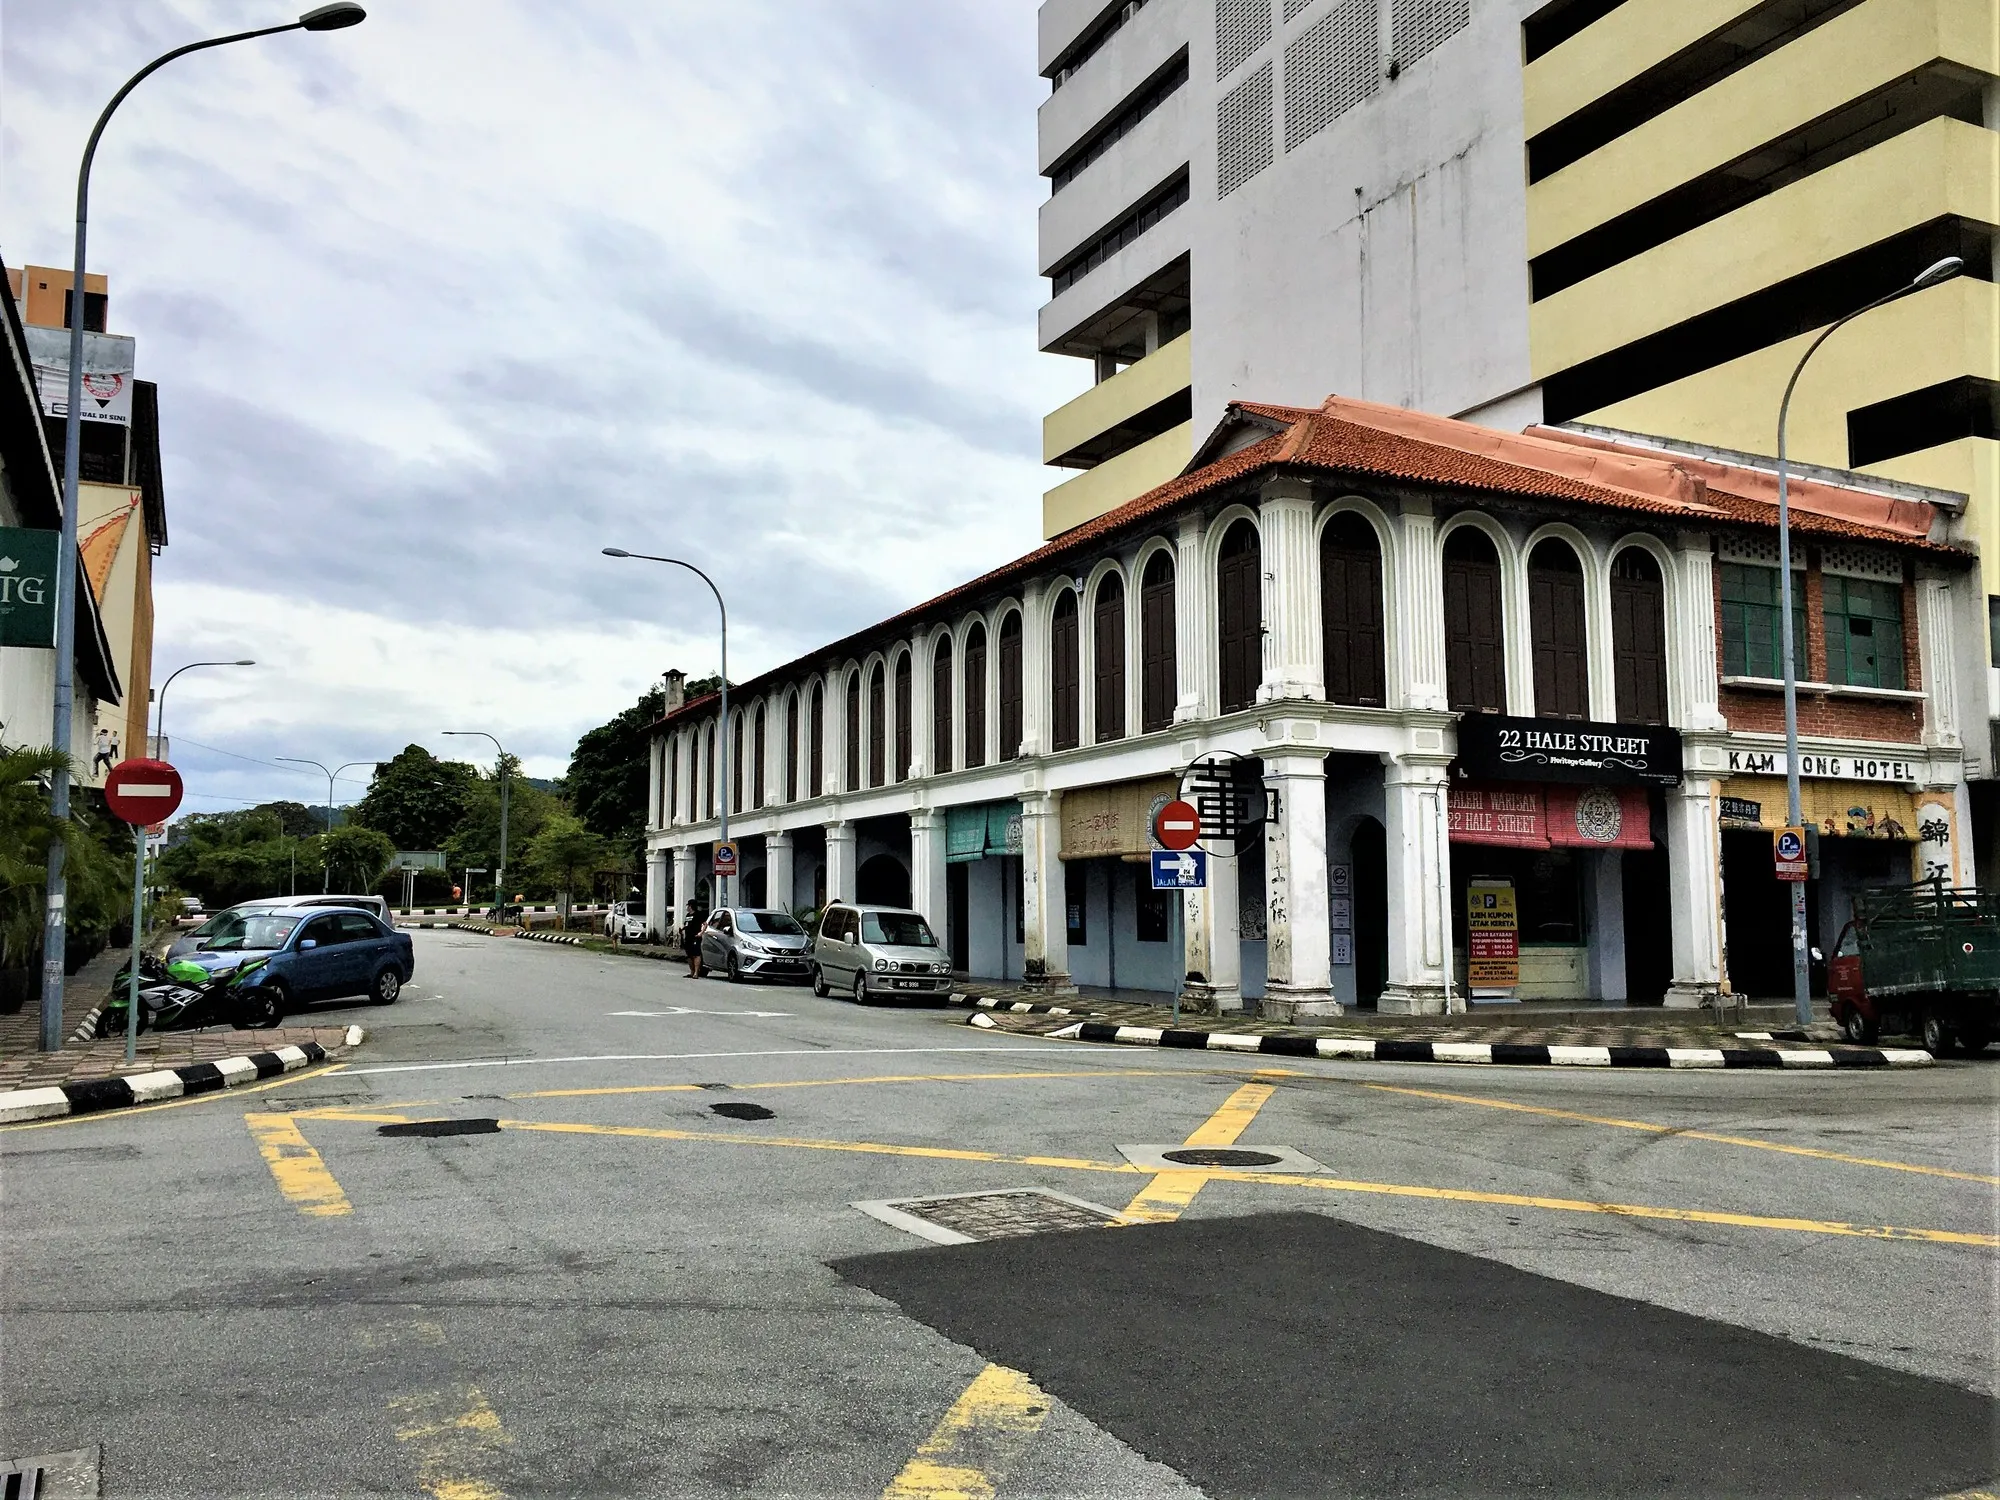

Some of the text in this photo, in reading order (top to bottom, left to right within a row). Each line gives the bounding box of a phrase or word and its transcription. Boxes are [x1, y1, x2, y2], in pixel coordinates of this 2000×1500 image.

[1499, 730, 1650, 755] 22 HALE STREET
[1728, 752, 1775, 772] KAM
[1854, 759, 1915, 781] HOTEL
[1489, 792, 1536, 812] WARISAN
[1466, 813, 1492, 831] HALE
[1497, 815, 1536, 834] STREET
[1782, 836, 1791, 850] P
[1156, 878, 1176, 886] JALAN
